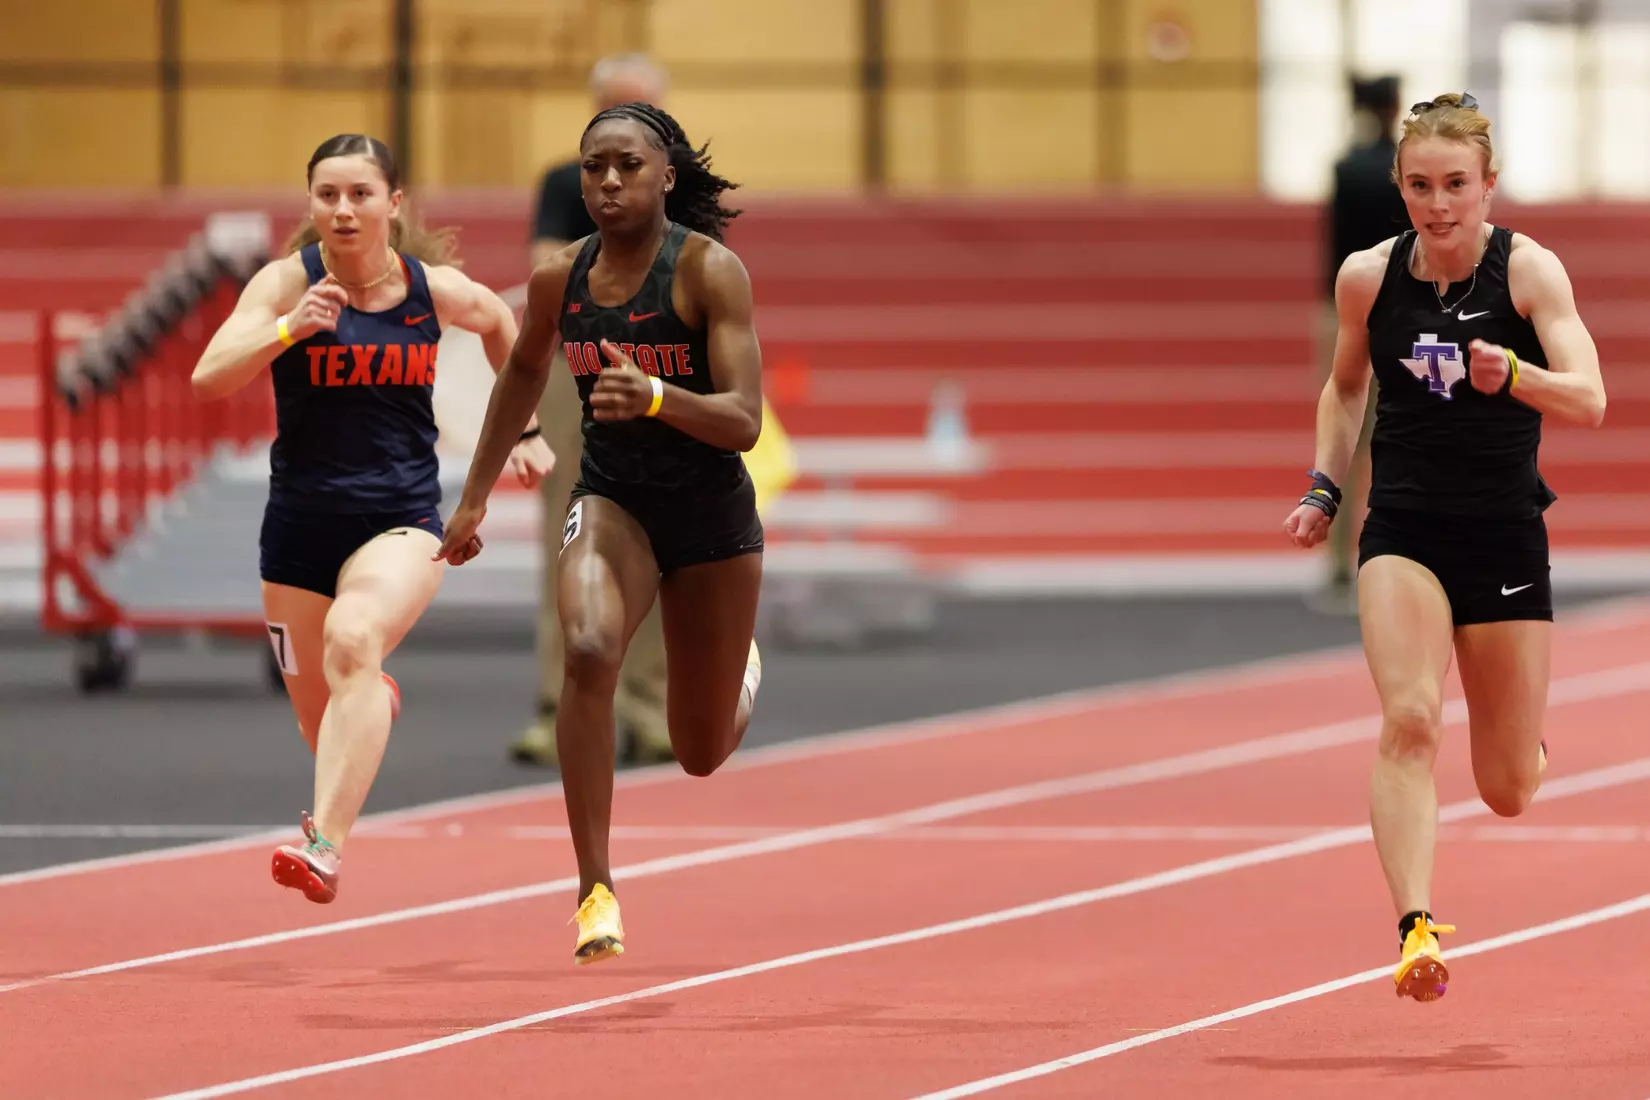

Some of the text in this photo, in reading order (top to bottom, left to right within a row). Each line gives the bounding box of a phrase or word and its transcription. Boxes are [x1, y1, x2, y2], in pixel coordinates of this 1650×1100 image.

[306, 343, 439, 386] TEXANS
[1413, 342, 1458, 391] T
[268, 625, 286, 669] 7
